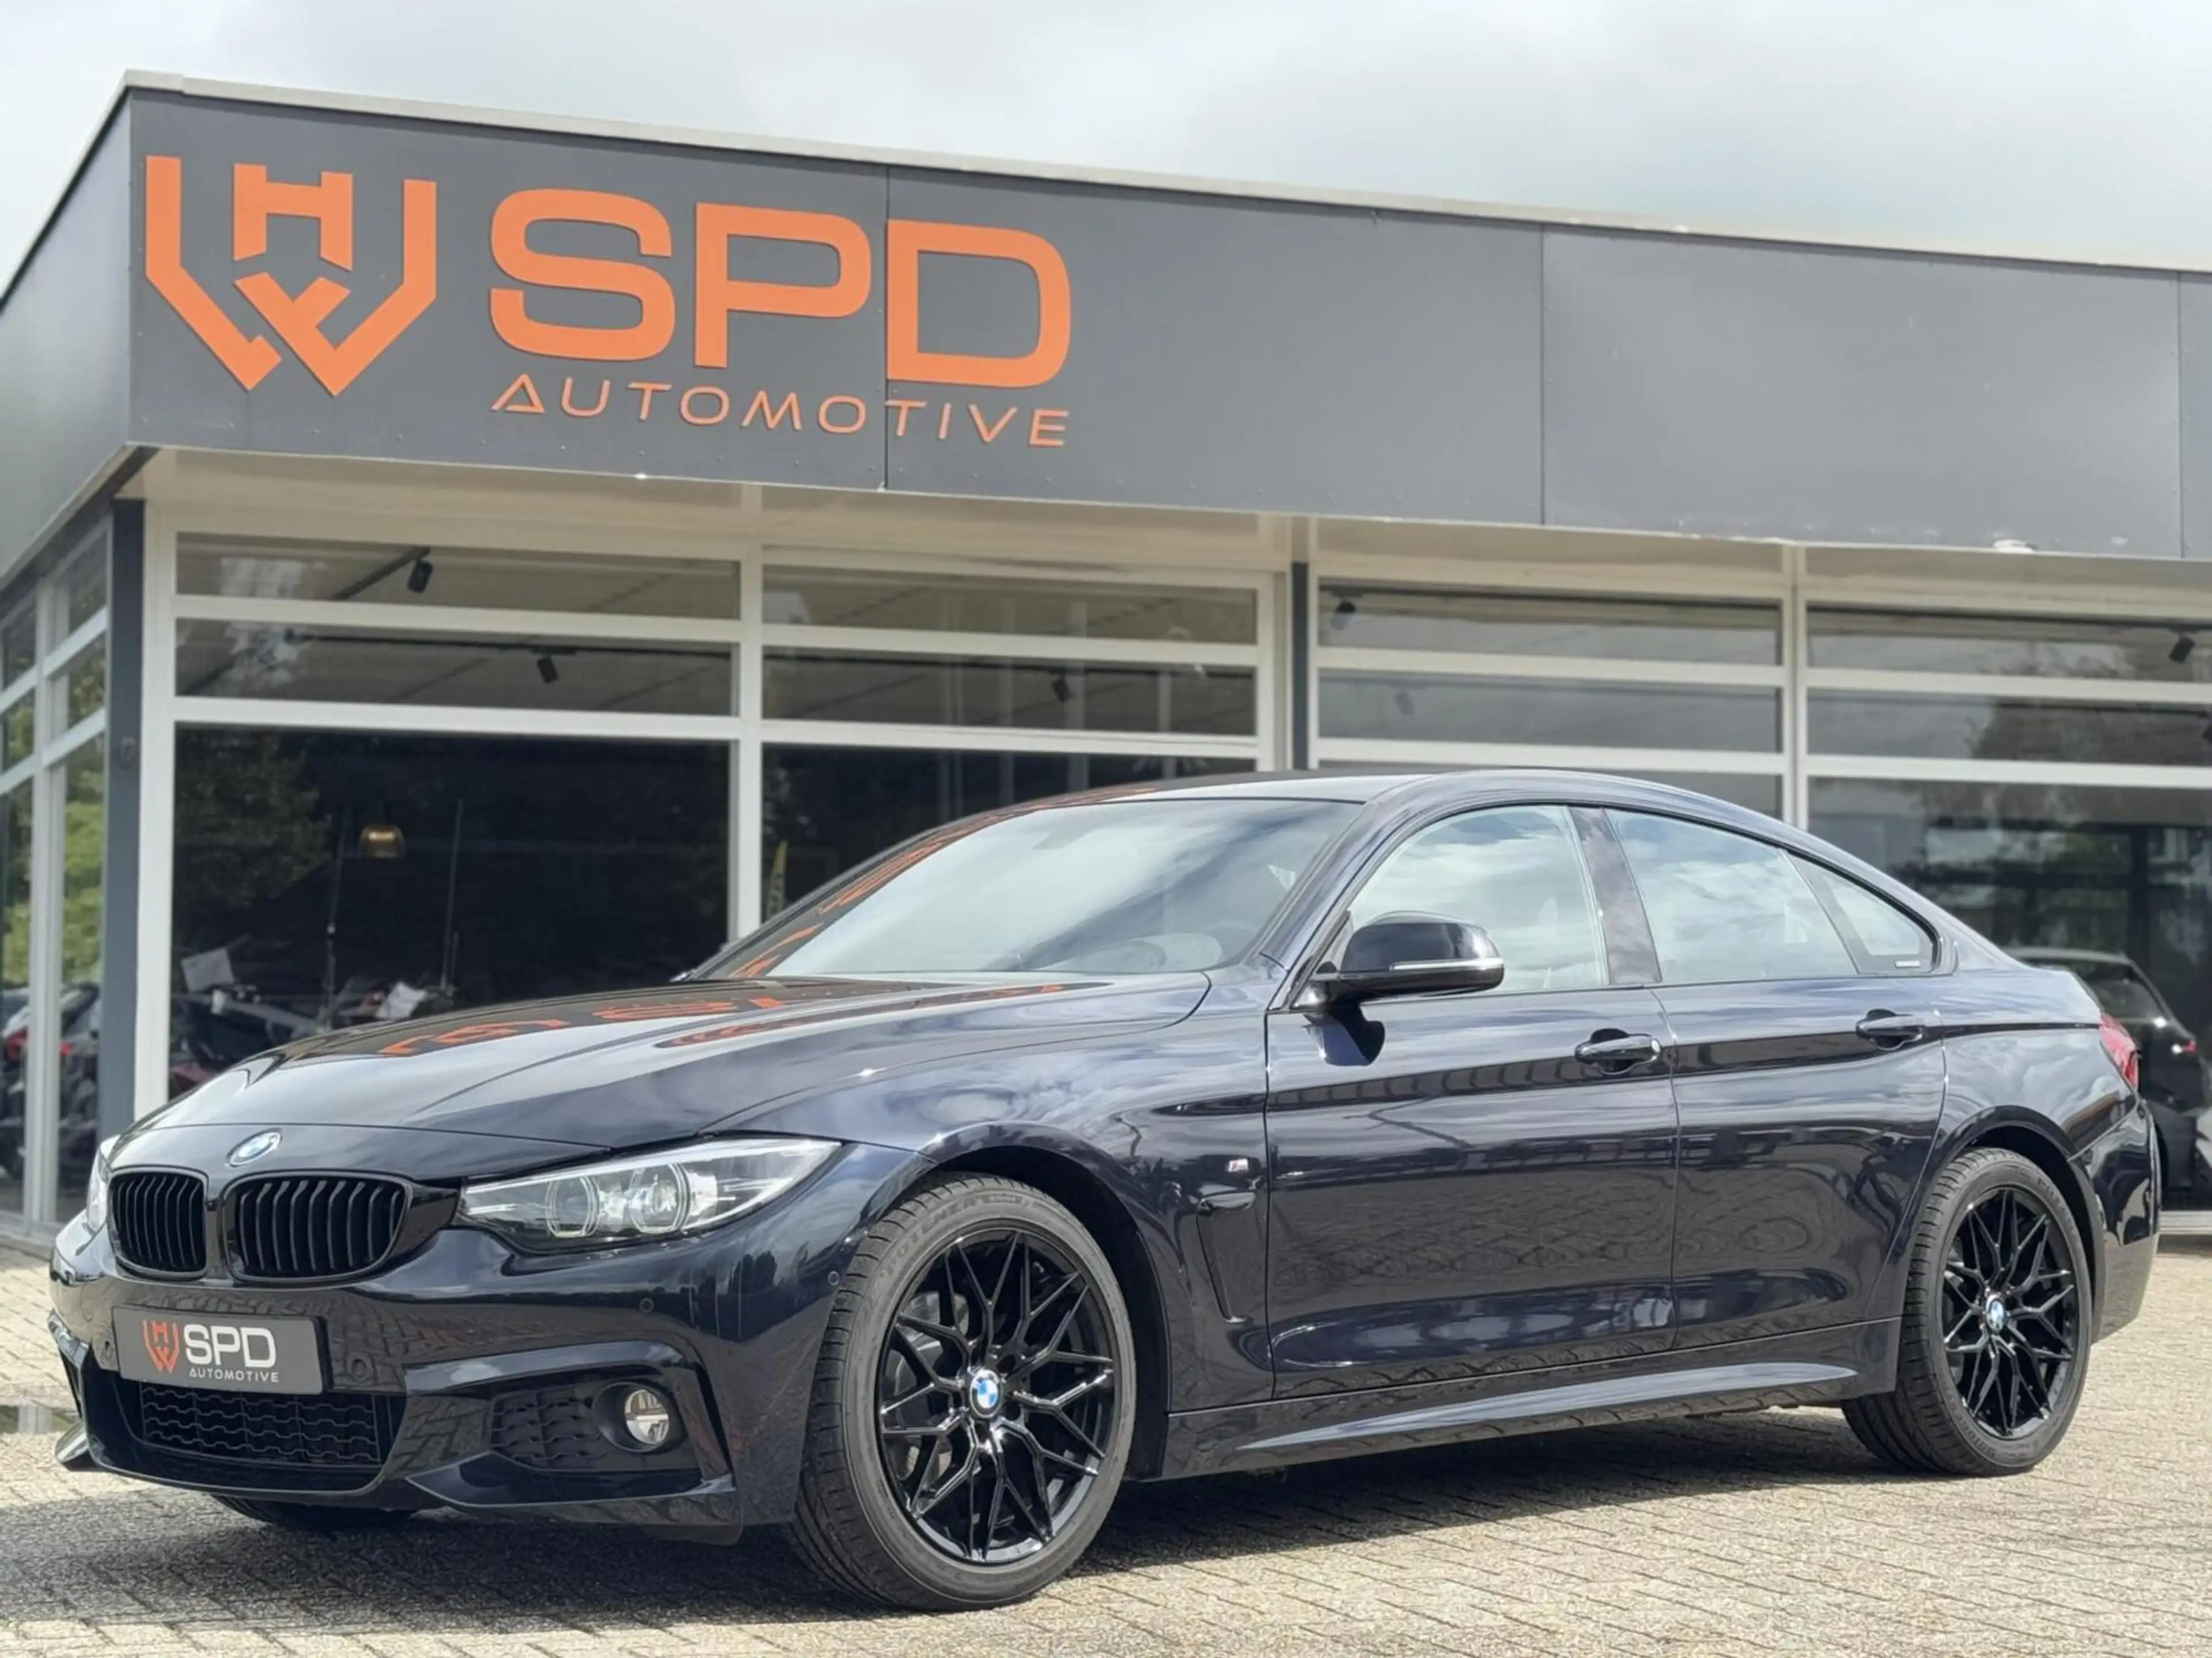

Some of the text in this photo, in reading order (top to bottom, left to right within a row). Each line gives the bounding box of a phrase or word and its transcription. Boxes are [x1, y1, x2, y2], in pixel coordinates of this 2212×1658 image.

[488, 188, 1071, 389] SPD
[490, 373, 1070, 447] AUTOMOTIVE
[183, 1323, 276, 1369] SPD
[189, 1367, 279, 1383] AUTOMOTIVE
